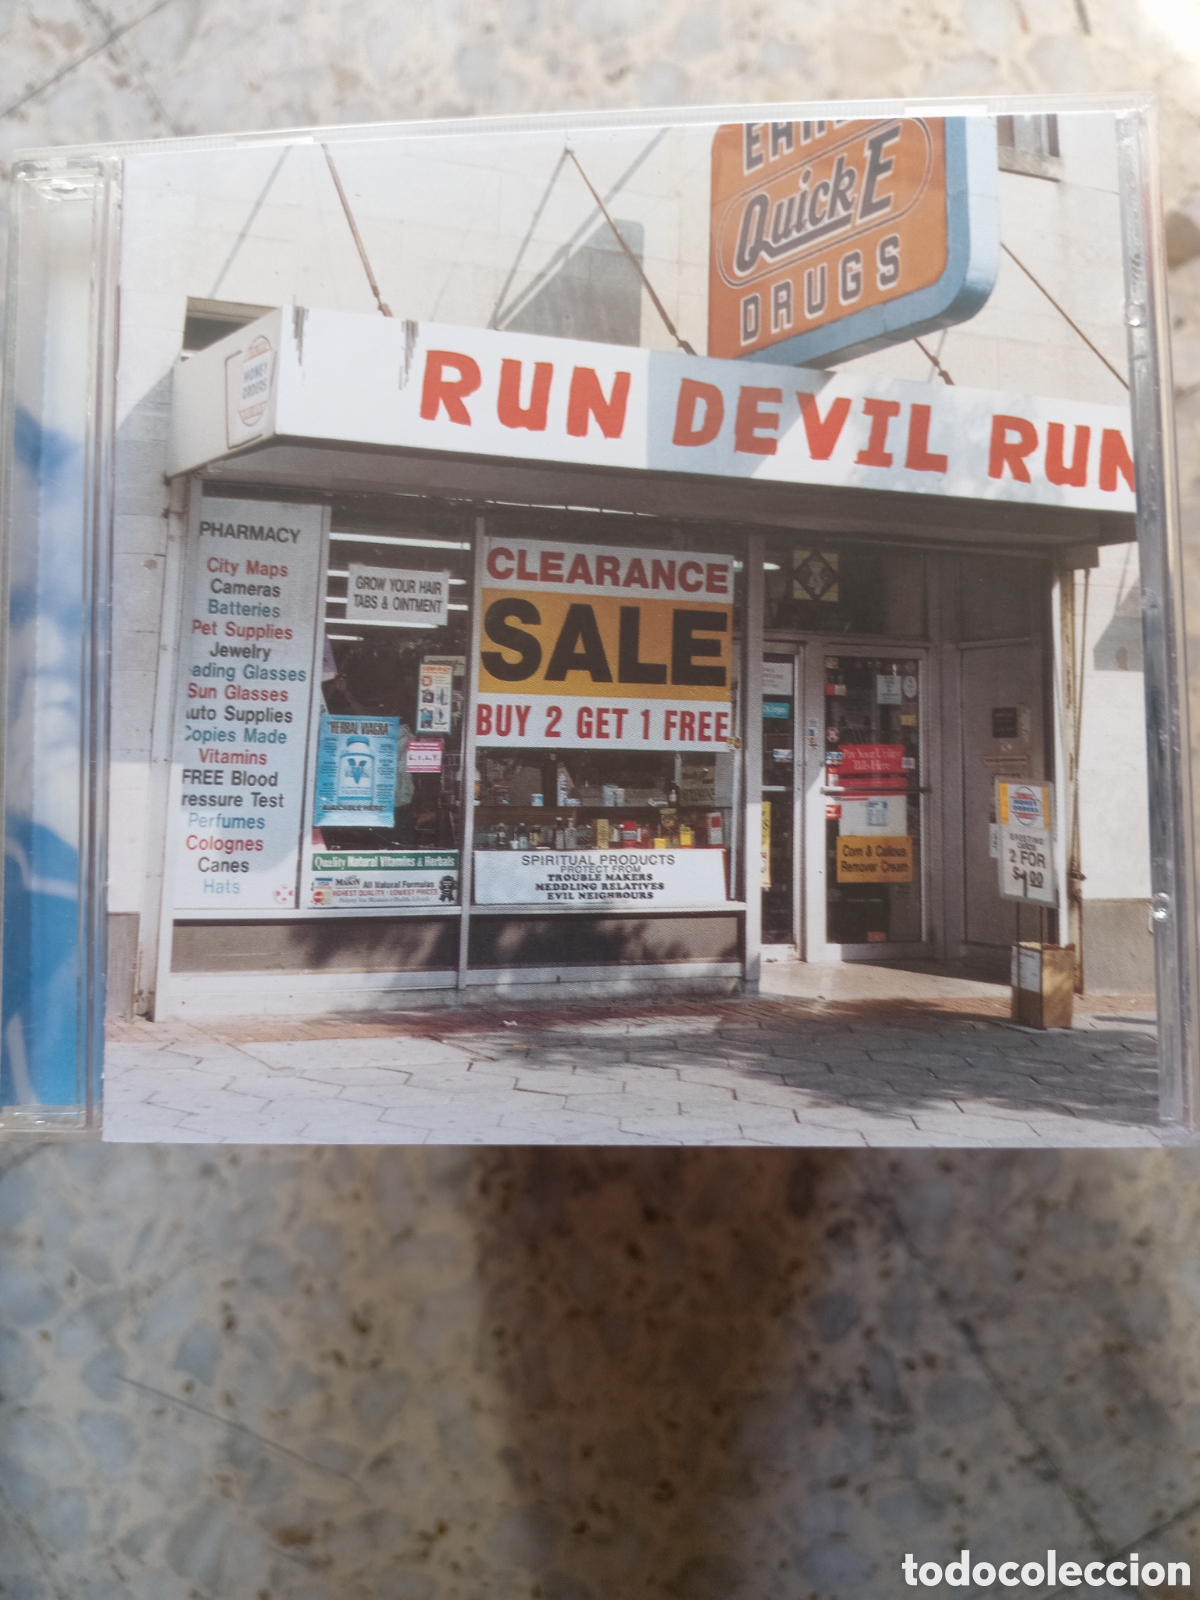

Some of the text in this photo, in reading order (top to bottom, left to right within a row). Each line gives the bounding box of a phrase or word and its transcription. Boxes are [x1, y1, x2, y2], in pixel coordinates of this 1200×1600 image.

[740, 234, 900, 347] DRUGS
[419, 350, 1135, 493] RUN DEVIL RUN
[199, 521, 301, 544] PHARMACY
[207, 557, 288, 579] City Maps
[486, 547, 729, 594] CLEARANCE
[210, 578, 280, 598] Cameras
[356, 576, 442, 595] GROW YOUR HAIR
[208, 599, 280, 618] Batteries
[353, 594, 443, 613] TABS & OINTMENT
[192, 619, 293, 641] Pet Supplies
[480, 597, 727, 687] SALE
[209, 642, 271, 662] Jewelry
[243, 664, 306, 682] Glasses
[187, 682, 289, 702] Sun Glasses
[224, 705, 293, 725] Supplies
[477, 704, 728, 743] BUY 2 GET 1 FREE
[243, 727, 287, 744] Made
[199, 748, 267, 765] Vitamins
[182, 769, 278, 787] FREE Blood
[250, 792, 284, 808] Test
[188, 812, 265, 829] Perfumes
[186, 835, 263, 854] Colognes
[198, 856, 250, 873] Canes
[314, 856, 346, 870] Quality
[347, 856, 379, 868] Natural
[380, 856, 415, 868] Vitamins
[424, 855, 455, 868] Herbals
[521, 854, 676, 866] SPIRITUAL PRODUCTS
[1009, 849, 1046, 869] 2 FOR
[547, 873, 654, 882] TROUBLE MAKERS
[560, 865, 642, 874] PROTECT FROM
[203, 879, 240, 894] Hats
[535, 882, 665, 891] MEDDLING RELATIVES
[547, 891, 654, 900] EVIL NEIGHBOURS
